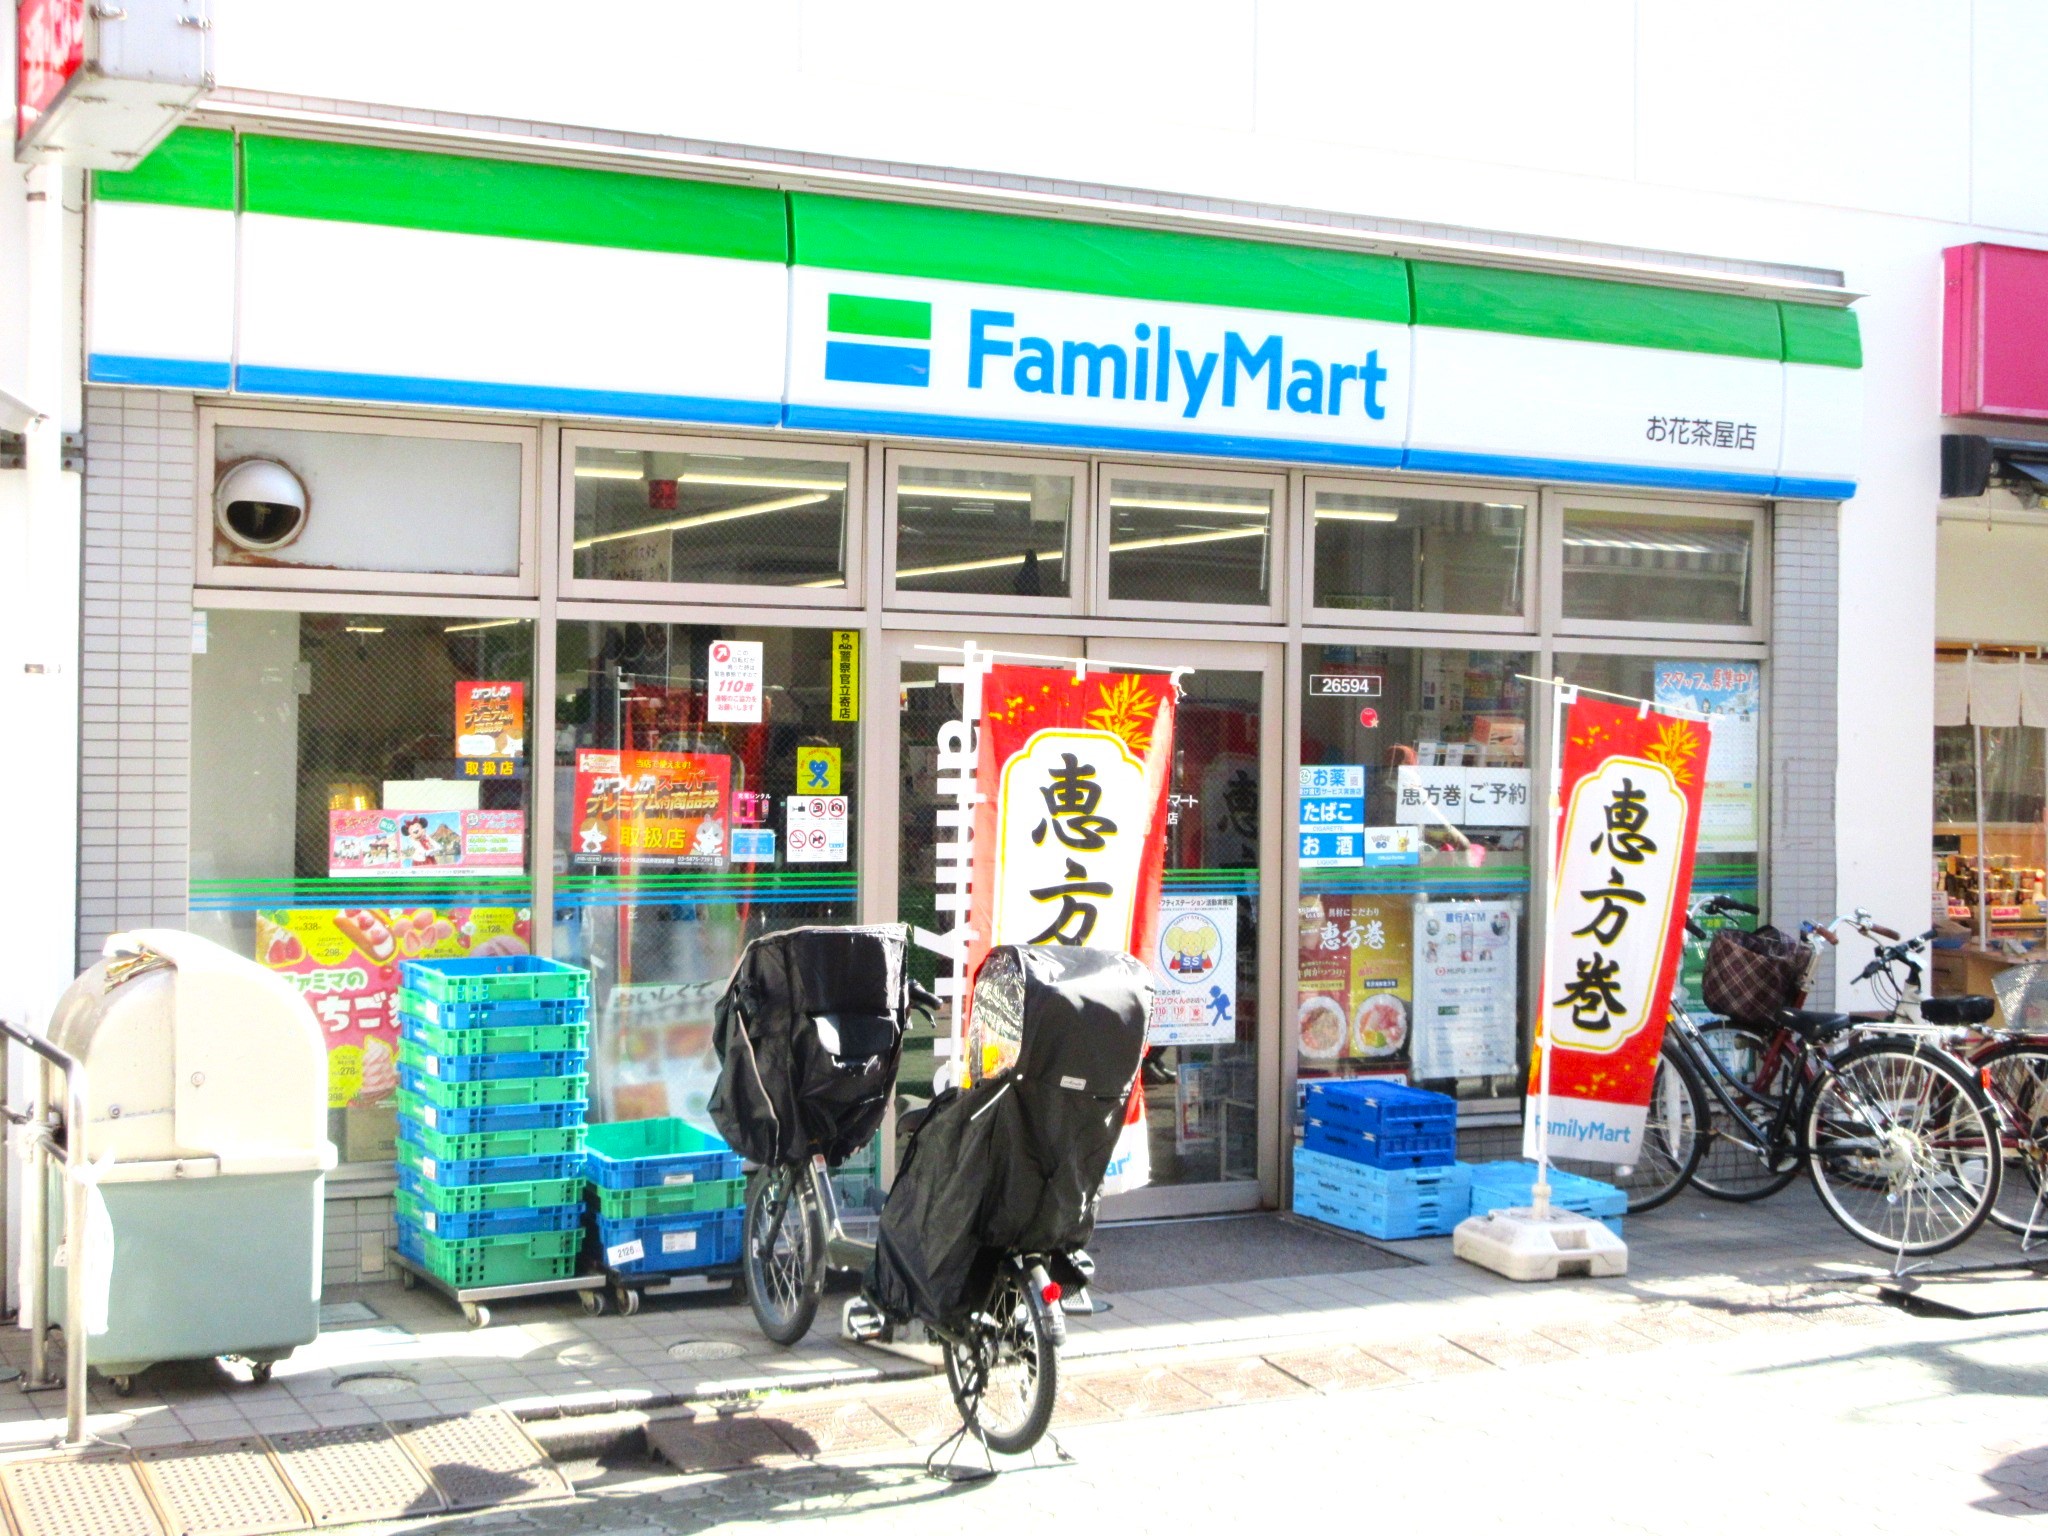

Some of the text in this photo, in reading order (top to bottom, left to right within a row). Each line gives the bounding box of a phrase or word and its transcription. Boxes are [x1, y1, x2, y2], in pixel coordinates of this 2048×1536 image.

[967, 308, 1388, 420] FamilyMart
[1646, 415, 1757, 450] お花茶屋店
[471, 685, 511, 700] かつしか
[718, 680, 755, 693] 110番
[838, 650, 853, 720] 警察官立寄店
[1322, 678, 1370, 694] 26594
[464, 761, 514, 776] 取扱店
[1313, 768, 1346, 787] お薬
[1167, 794, 1199, 809] マート
[1469, 782, 1527, 807] ご予約
[1303, 802, 1353, 823] たばこ
[619, 826, 686, 848] 取扱店
[1158, 898, 1234, 907] フティステーション活動実施店
[1552, 777, 1658, 1031] 恵方巻
[1319, 919, 1386, 950] 恵方巻
[1182, 956, 1200, 966] SS
